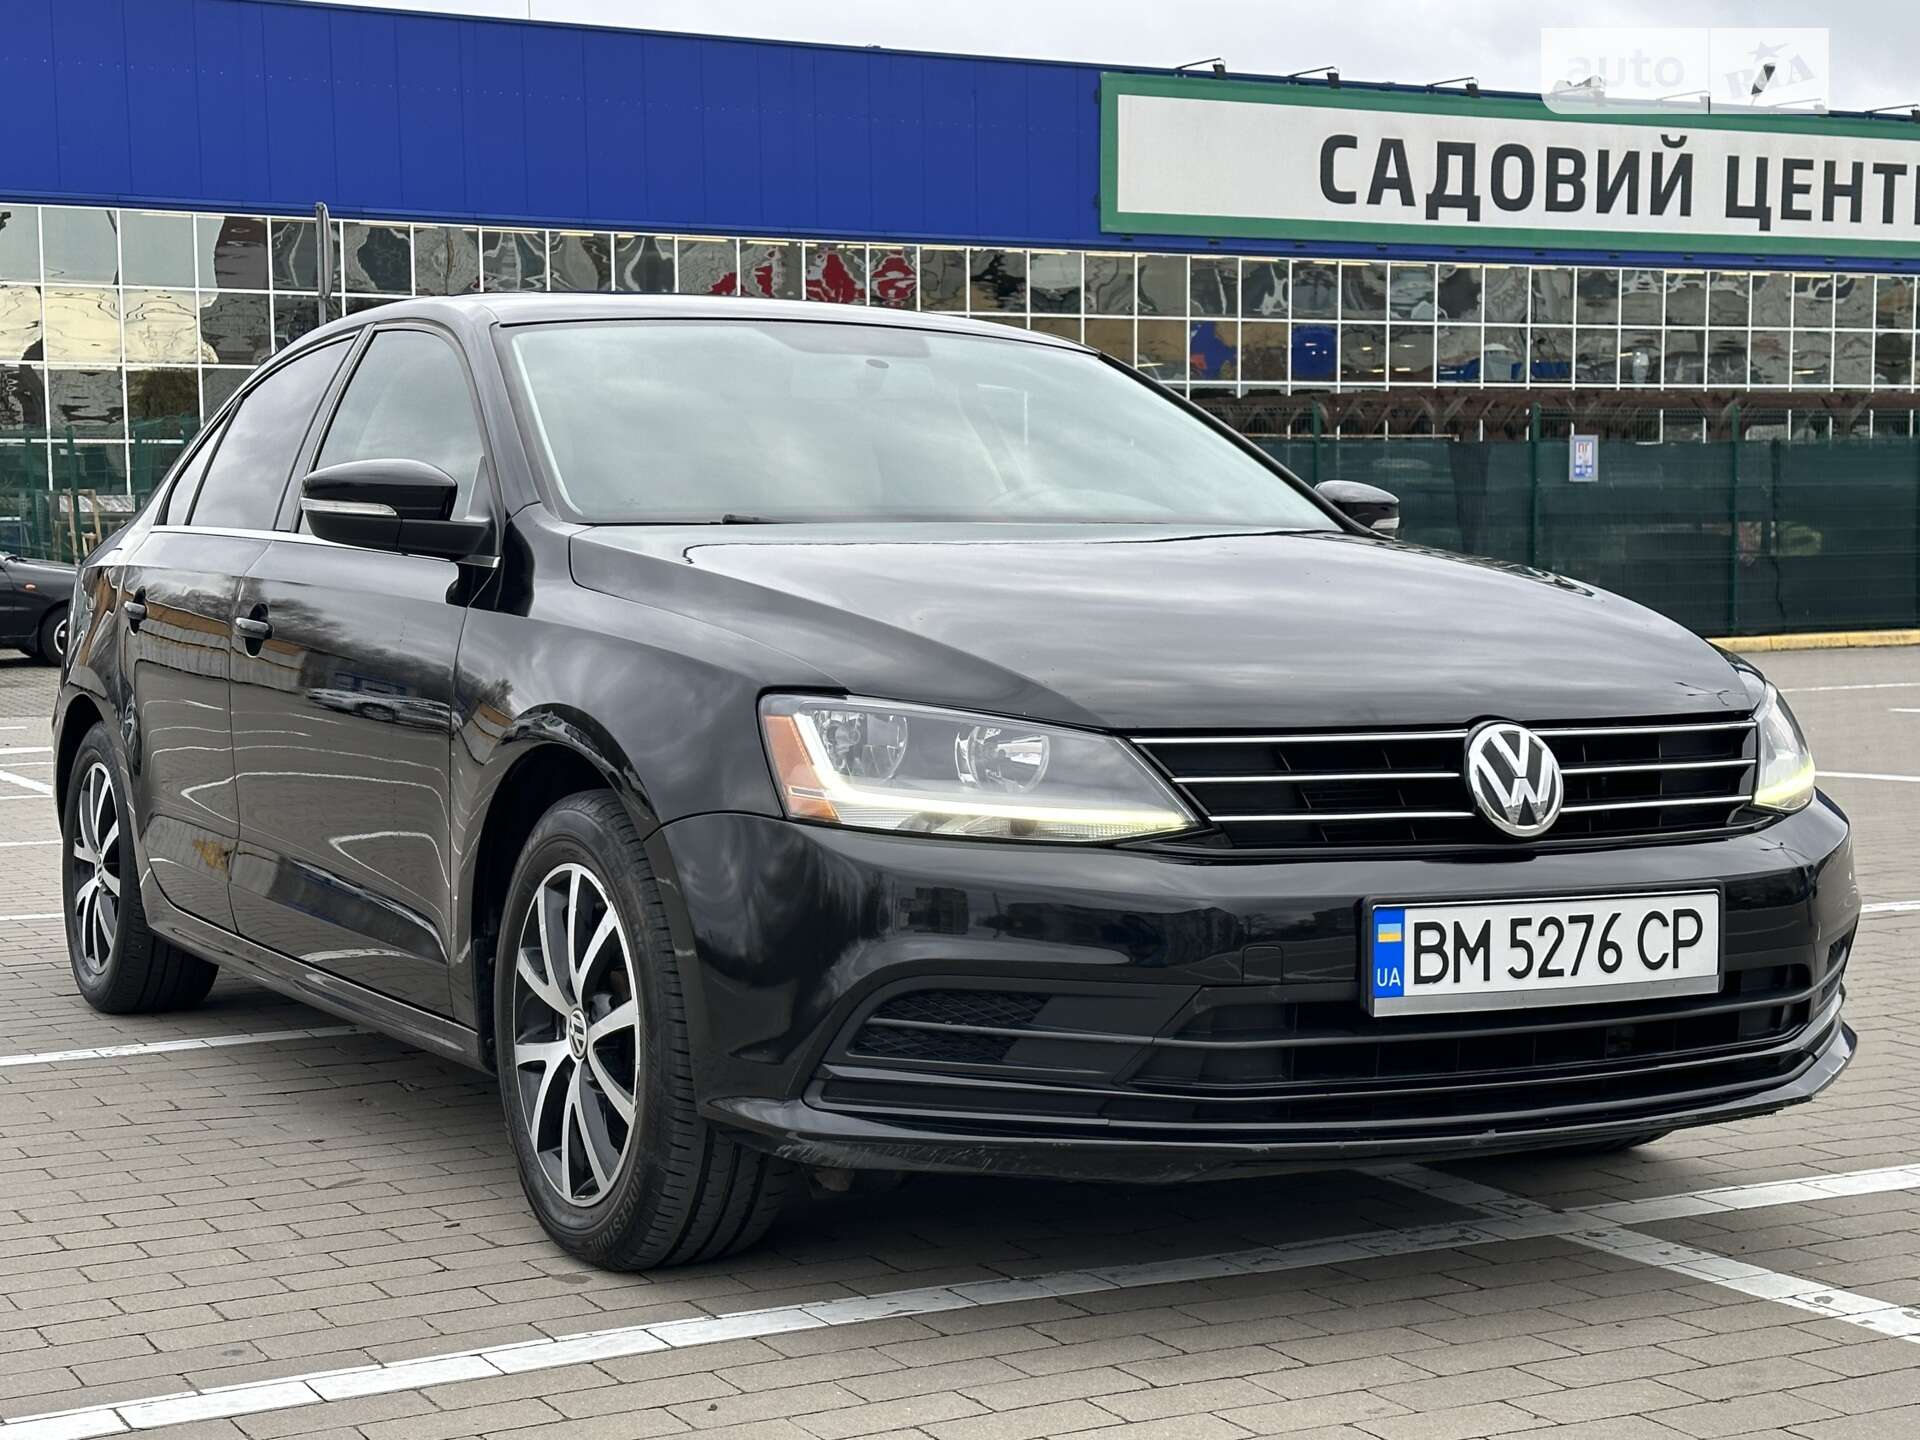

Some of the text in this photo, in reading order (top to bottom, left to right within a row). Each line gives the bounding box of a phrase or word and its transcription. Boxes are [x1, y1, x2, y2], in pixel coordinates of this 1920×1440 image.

[1319, 134, 1920, 231] САДОВИЙ ЦЕНТ
[1376, 967, 1401, 988] UA
[1413, 908, 1704, 985] BM 5276 CP
